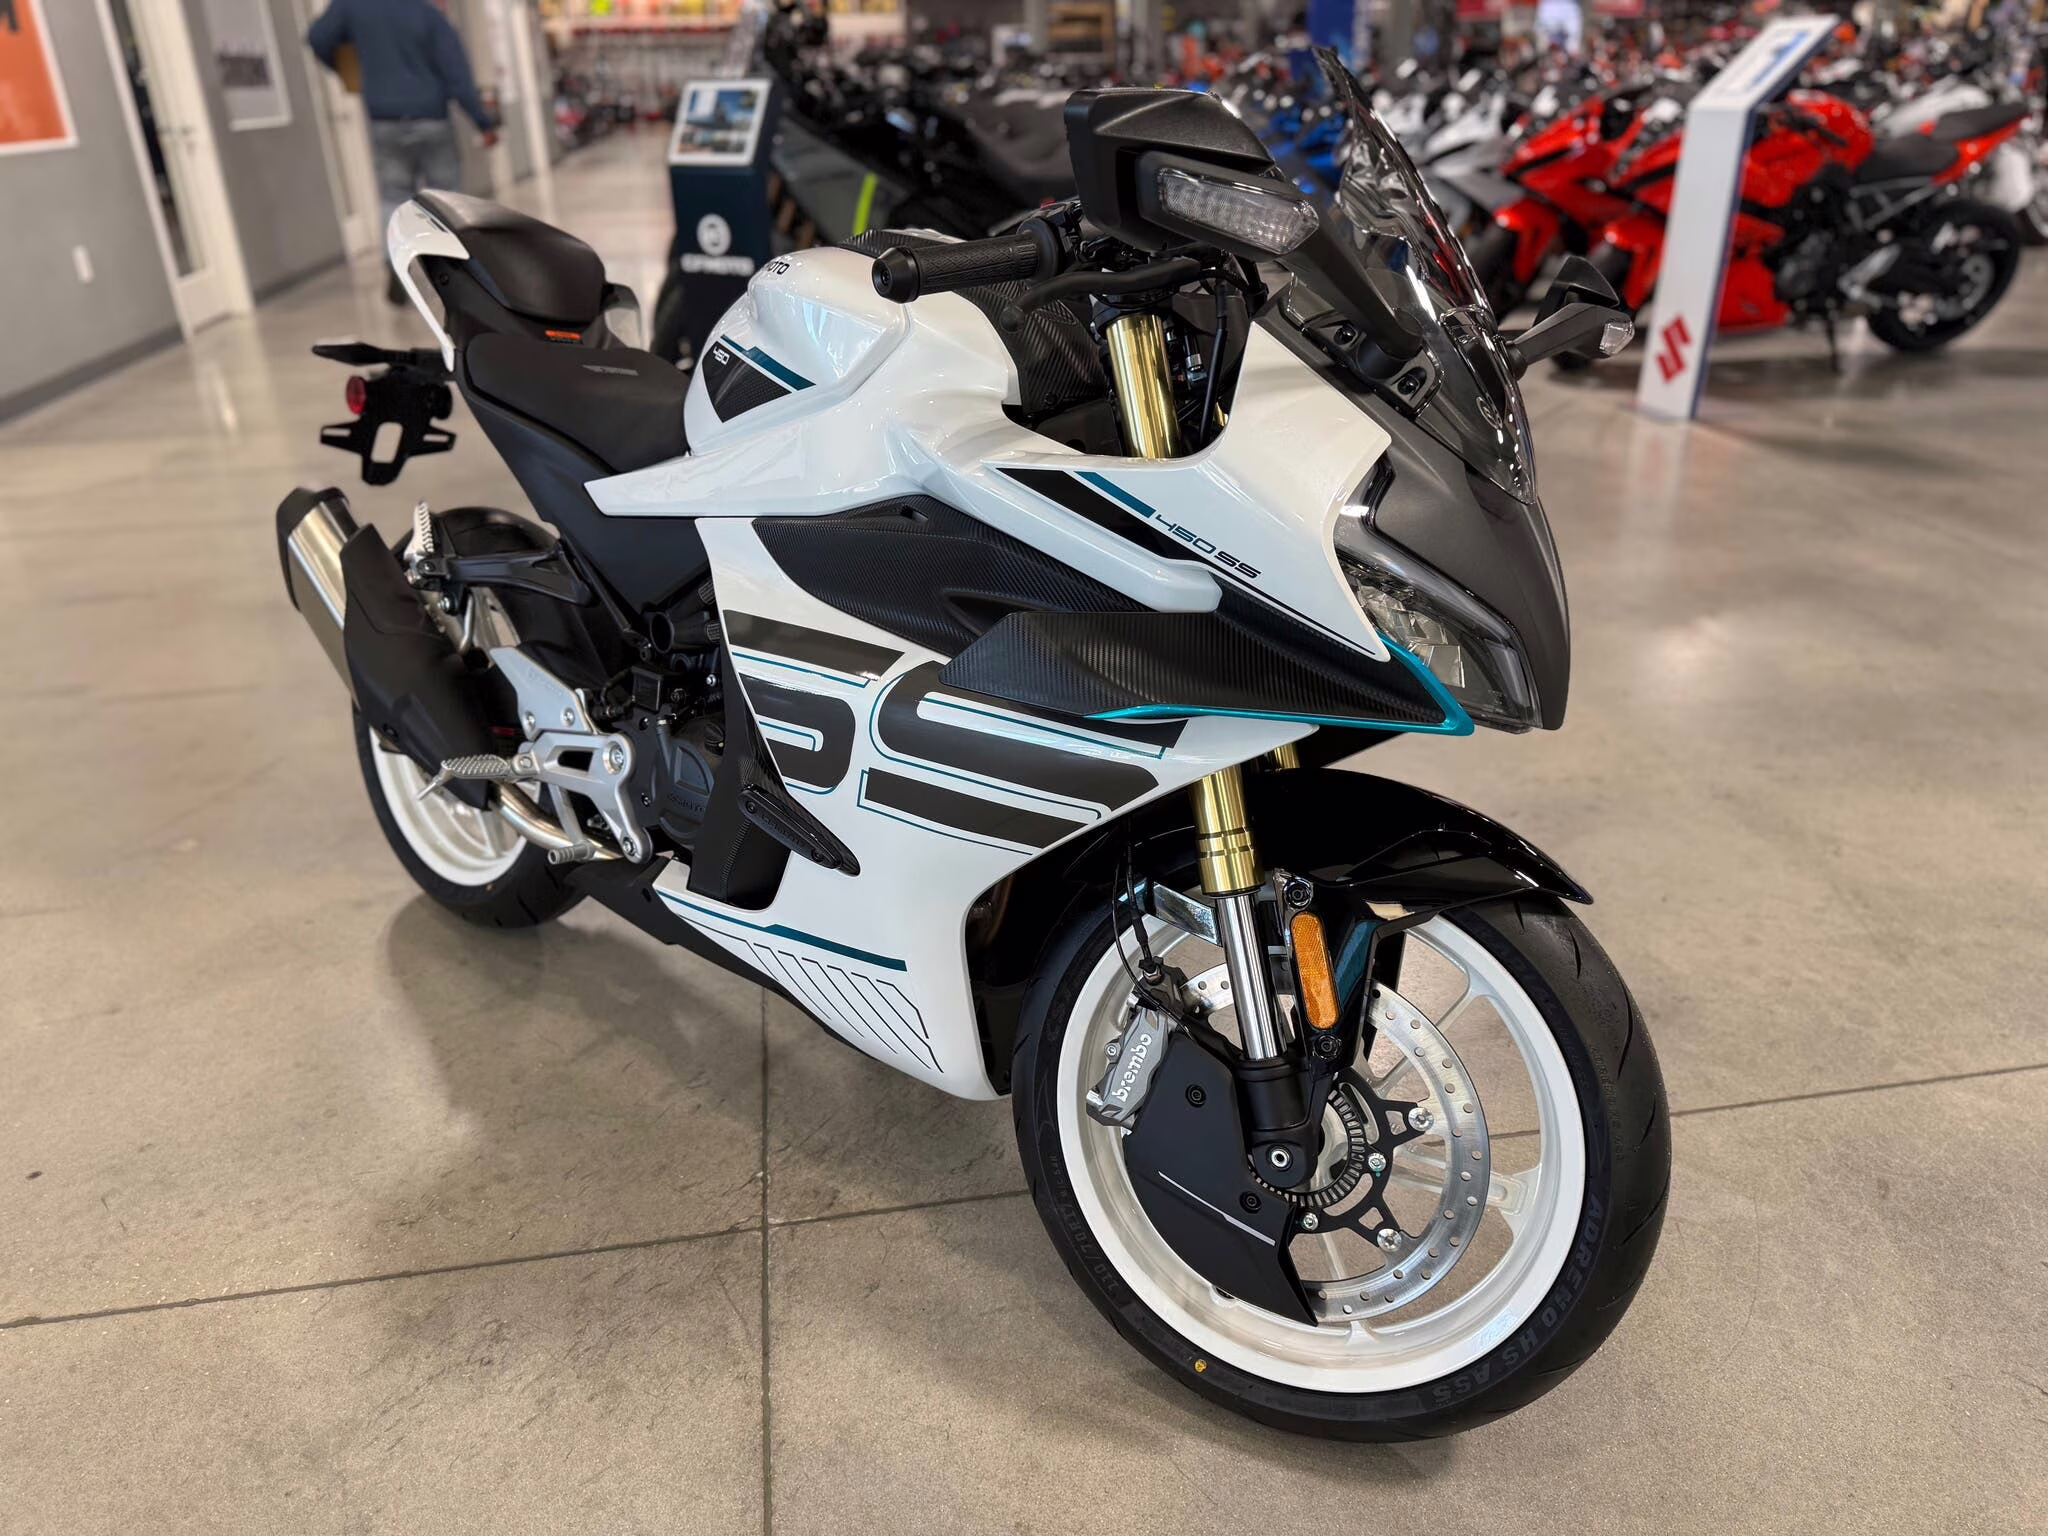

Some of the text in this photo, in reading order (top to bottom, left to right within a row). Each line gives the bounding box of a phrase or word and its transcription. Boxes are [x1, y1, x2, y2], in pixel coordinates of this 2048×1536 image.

[713, 346, 730, 365] 450
[1111, 1033, 1152, 1102] brembo
[1540, 1193, 1601, 1328] ADRENO
[1503, 1326, 1540, 1367] HS
